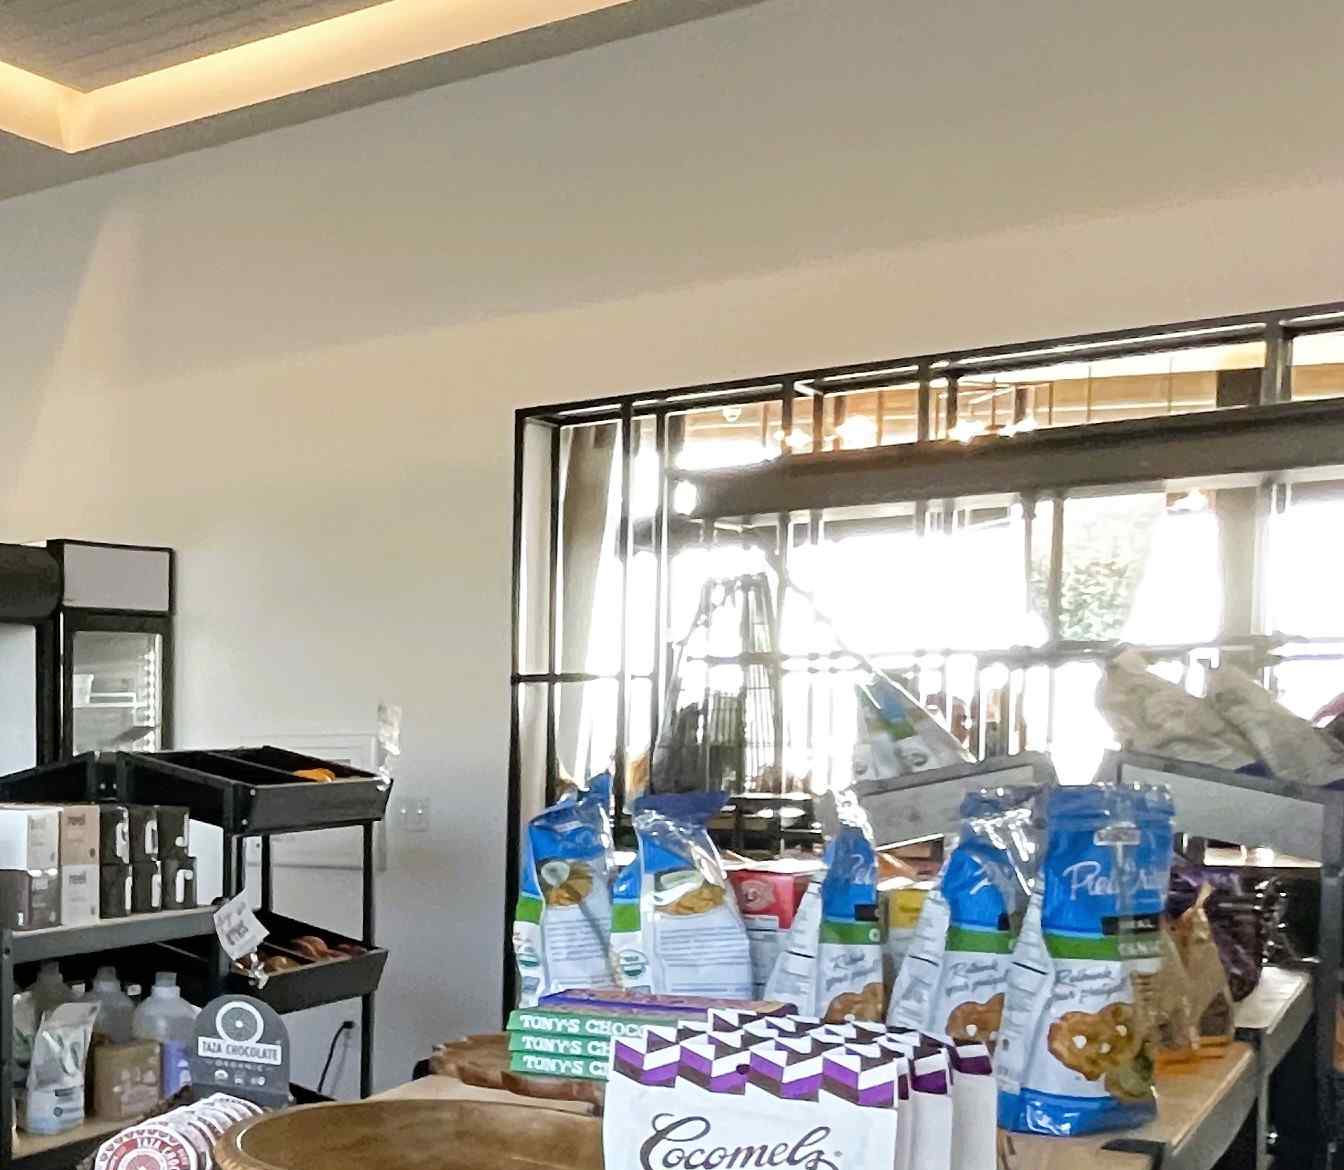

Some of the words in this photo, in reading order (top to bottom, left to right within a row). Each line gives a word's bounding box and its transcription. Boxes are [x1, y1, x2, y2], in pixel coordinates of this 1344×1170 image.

[519, 1015, 581, 1034] TONY'S
[202, 1041, 222, 1053] TAZA
[226, 1044, 278, 1061] CHOCOLATE
[521, 1036, 582, 1054] TONY'S
[522, 1055, 583, 1074] TONY'S
